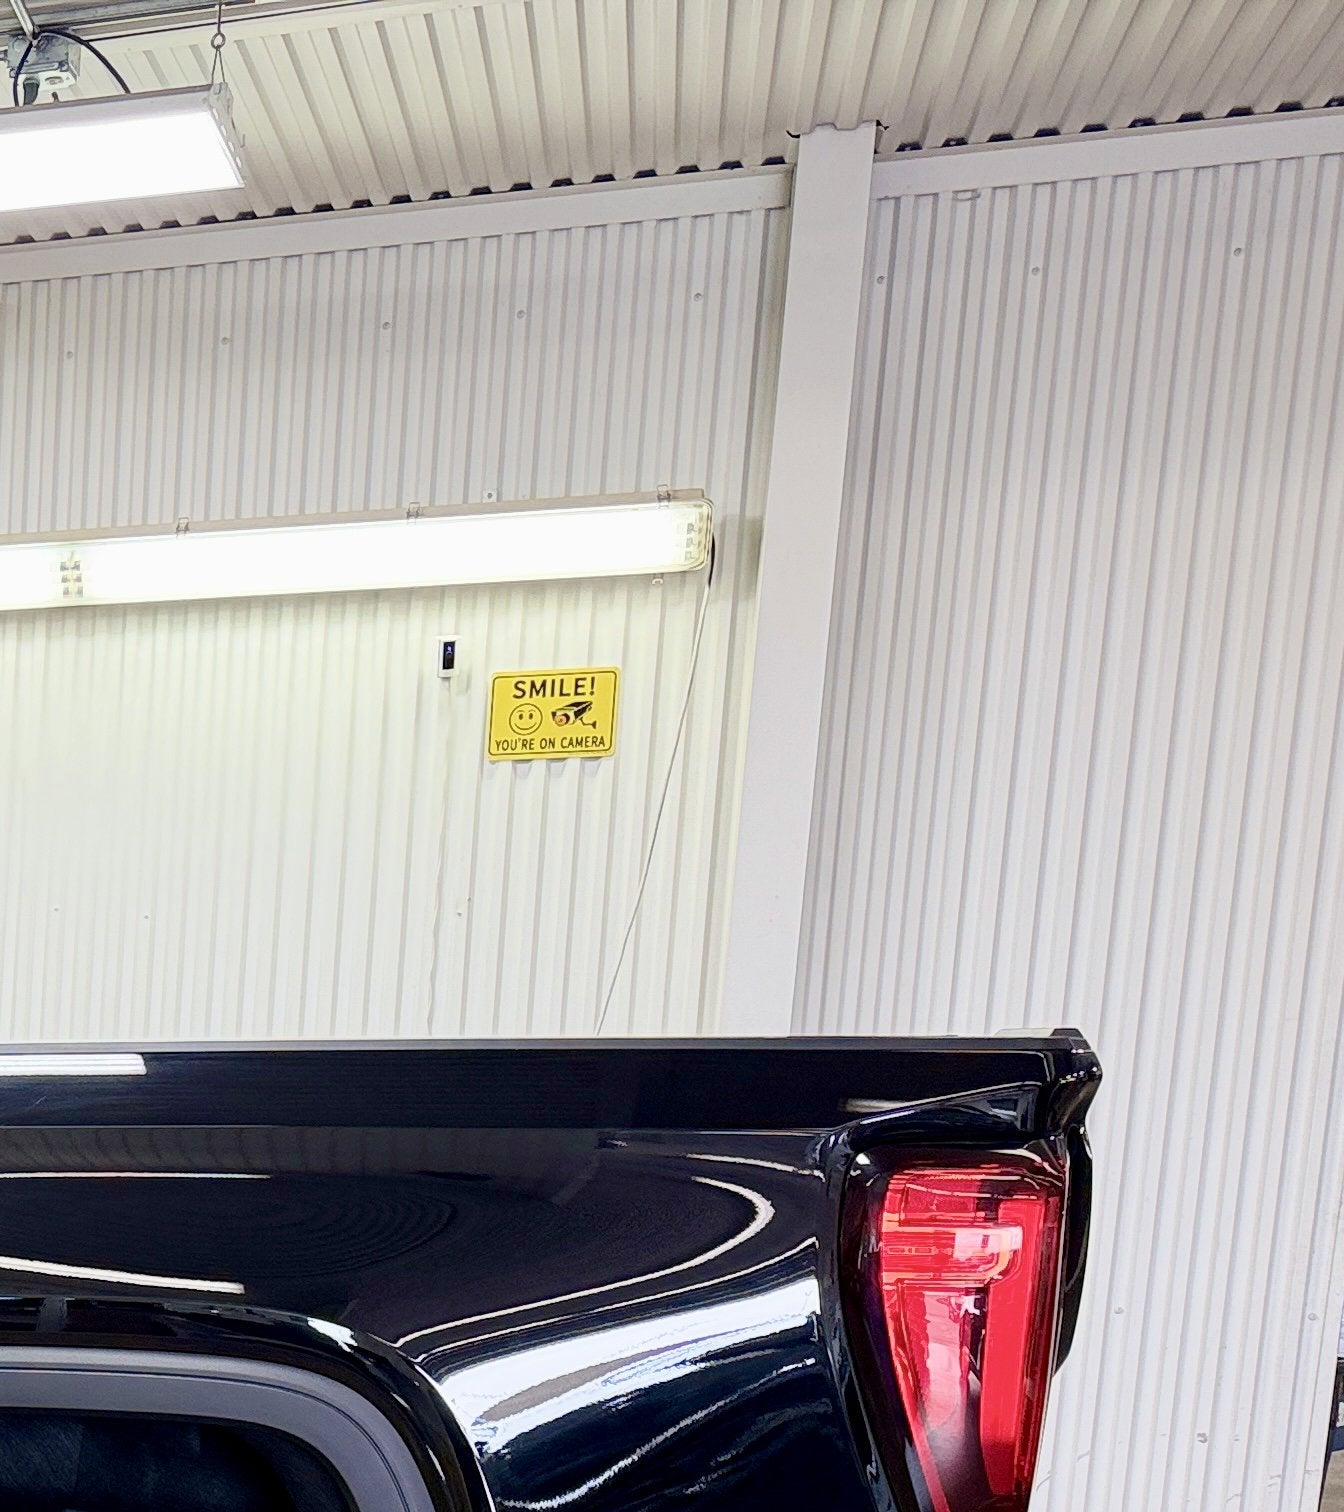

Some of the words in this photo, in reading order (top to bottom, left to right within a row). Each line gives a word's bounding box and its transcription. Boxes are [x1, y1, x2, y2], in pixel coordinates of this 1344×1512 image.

[512, 676, 596, 699] SMILE!
[495, 737, 535, 752] YOU'RE
[539, 737, 556, 750] ON
[560, 735, 606, 749] CAMERA
